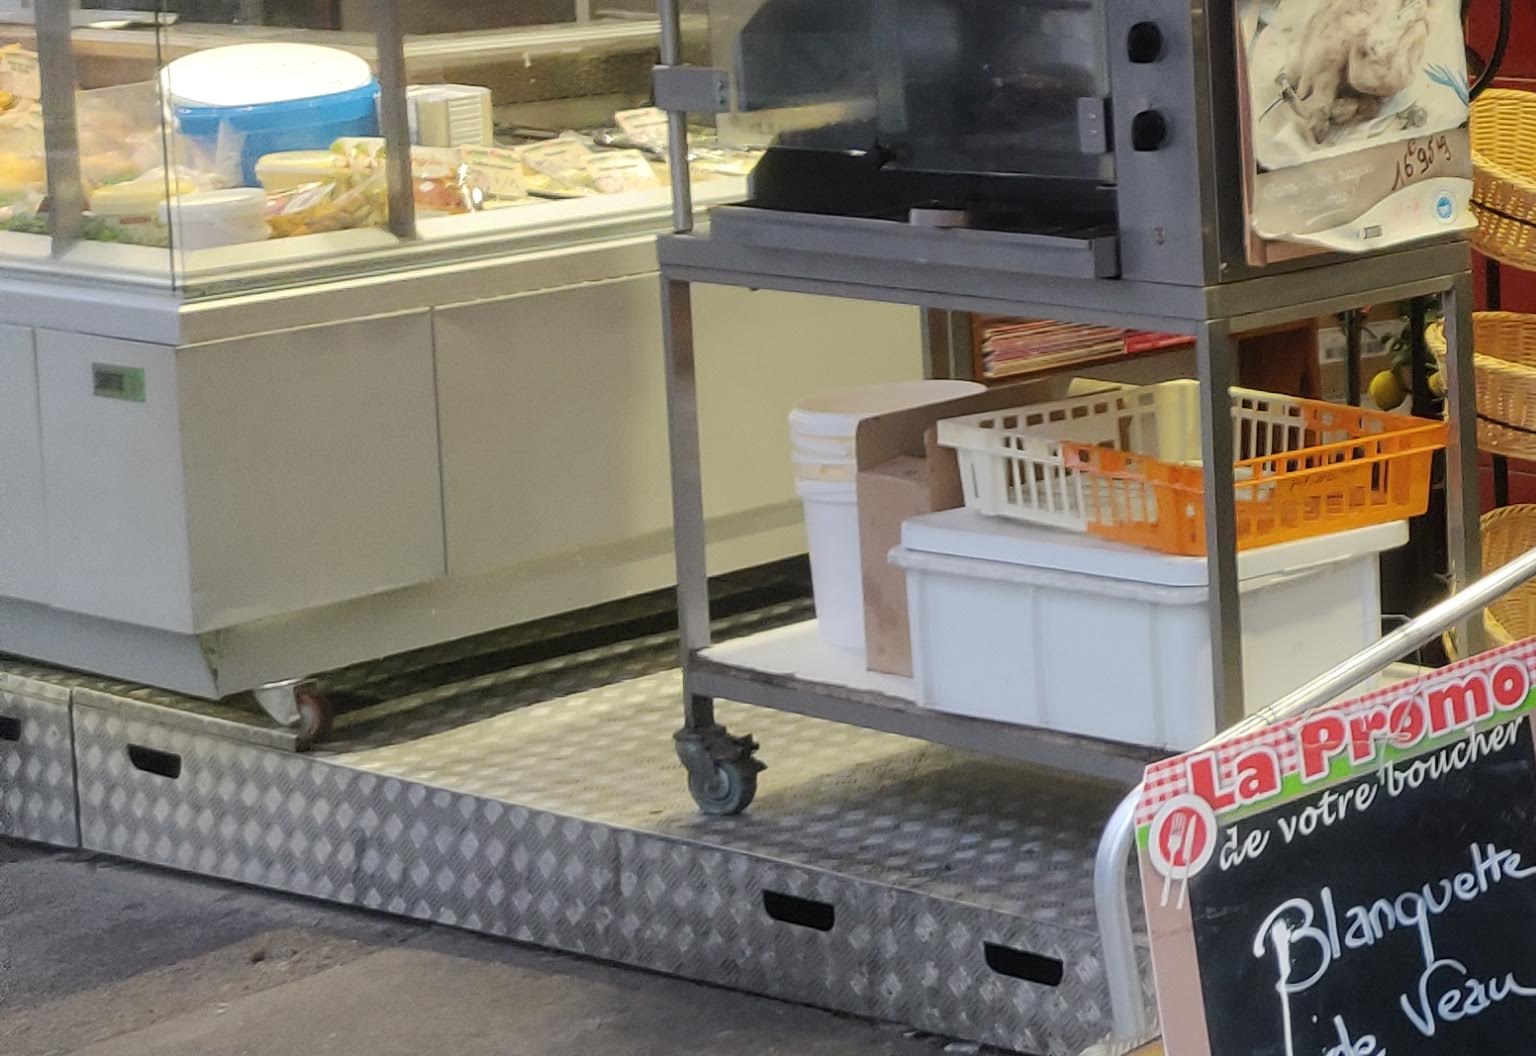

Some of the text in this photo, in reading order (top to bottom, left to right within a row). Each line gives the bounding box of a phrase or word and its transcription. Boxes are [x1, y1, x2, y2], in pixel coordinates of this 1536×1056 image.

[1184, 658, 1532, 816] La Promo
[1218, 712, 1525, 871] de votre boucher
